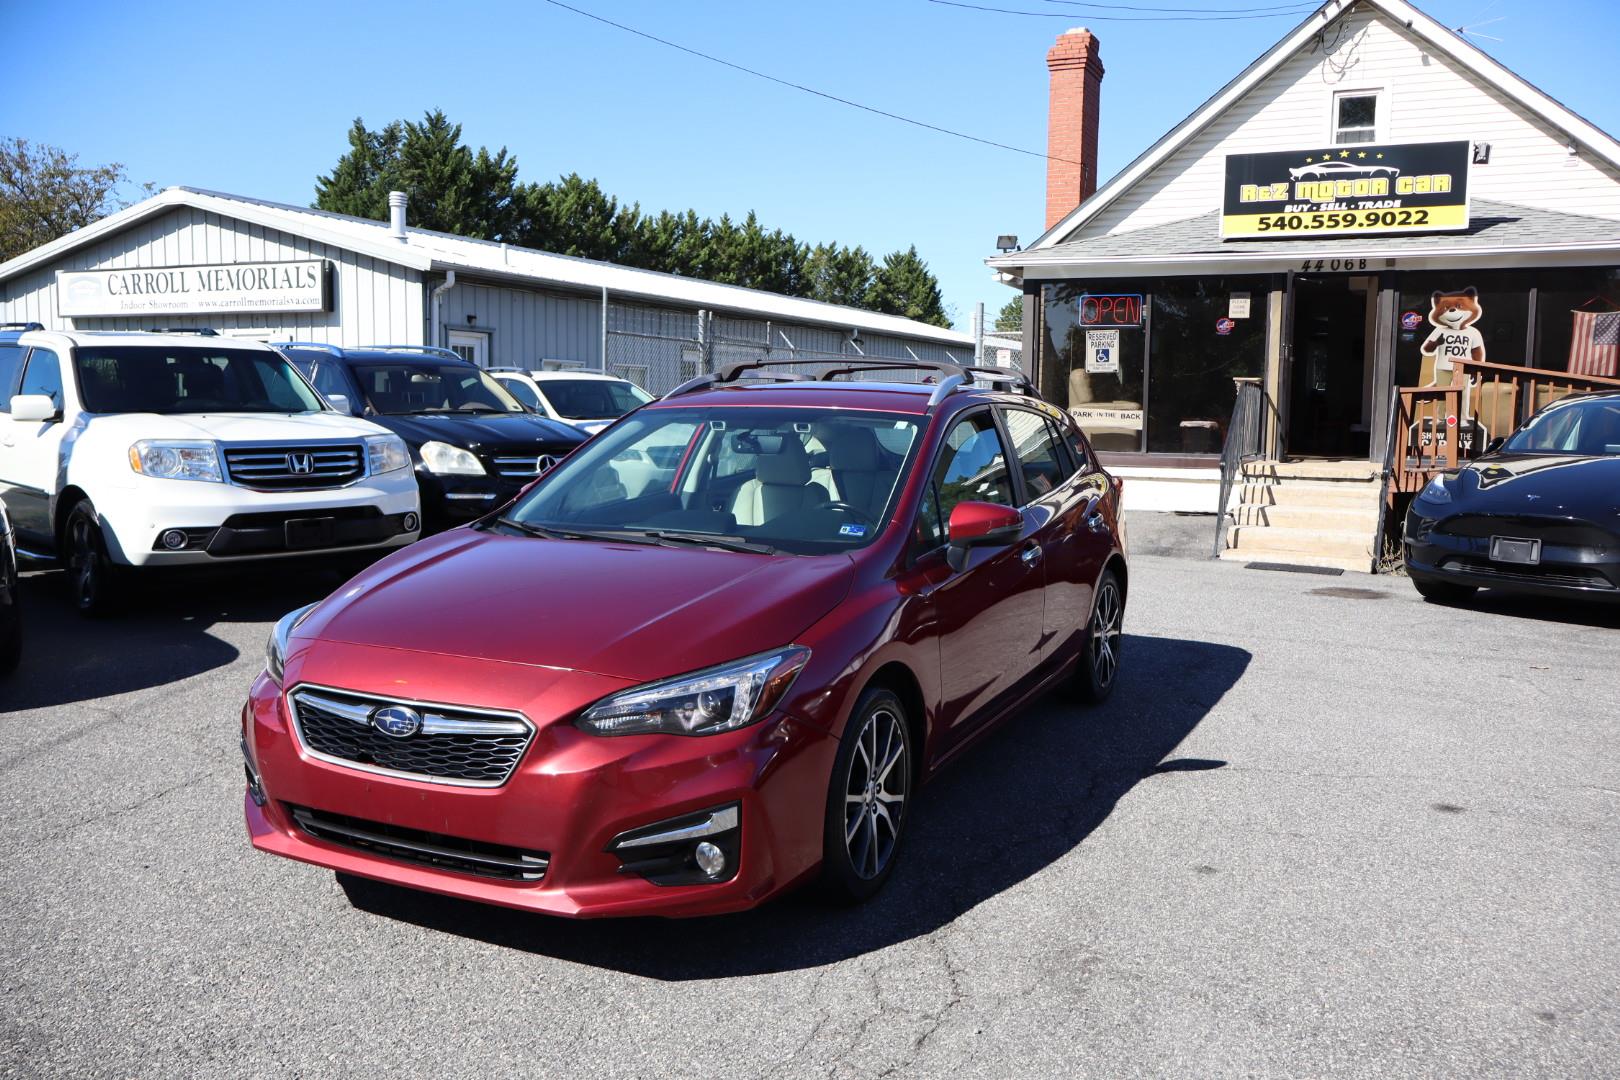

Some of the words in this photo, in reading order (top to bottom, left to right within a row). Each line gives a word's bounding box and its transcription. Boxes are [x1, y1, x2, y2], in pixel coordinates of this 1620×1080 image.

[1284, 204, 1311, 213] BUY
[1319, 202, 1348, 211] SELL
[1358, 200, 1401, 209] TRADE
[1258, 210, 1429, 231] 540.559.9022
[108, 271, 190, 295] CARROLL
[197, 265, 317, 292] MEMORIALS
[120, 300, 146, 310] Indoor
[149, 299, 189, 309] Showroom
[1082, 296, 1140, 324] OPEN
[1088, 333, 1117, 341] RESERVED
[1446, 335, 1470, 346] CAR
[1091, 341, 1115, 349] PARKING
[1444, 346, 1468, 357] FOX
[1421, 432, 1445, 440] SHW
